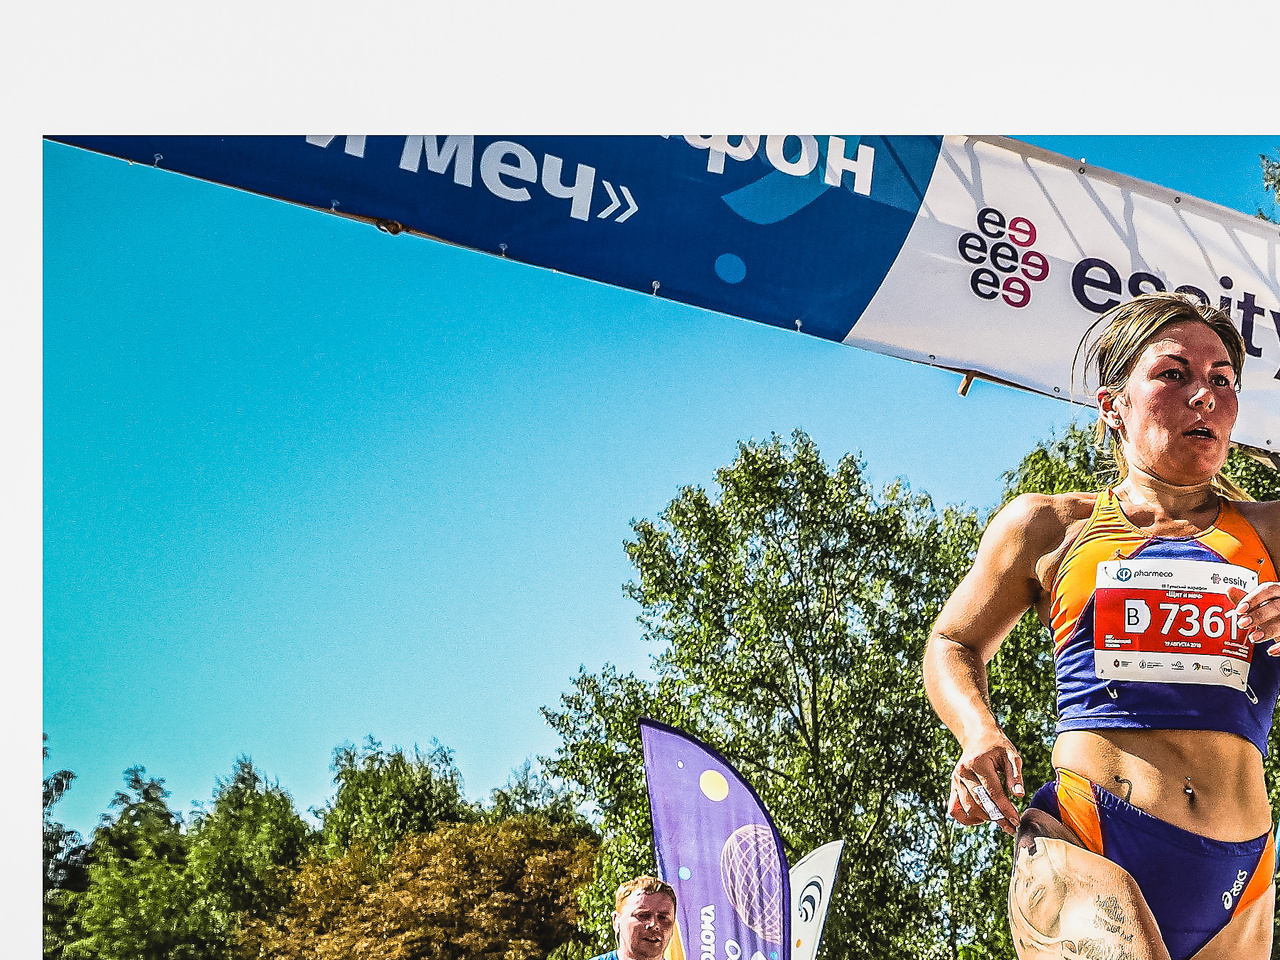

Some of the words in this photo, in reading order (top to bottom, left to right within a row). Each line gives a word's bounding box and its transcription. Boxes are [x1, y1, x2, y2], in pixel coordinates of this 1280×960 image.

[661, 135, 875, 196] фон
[1133, 570, 1174, 579] pharmeco
[1223, 576, 1248, 589] essity
[1127, 607, 1140, 626] B
[1159, 602, 1239, 640] 7361
